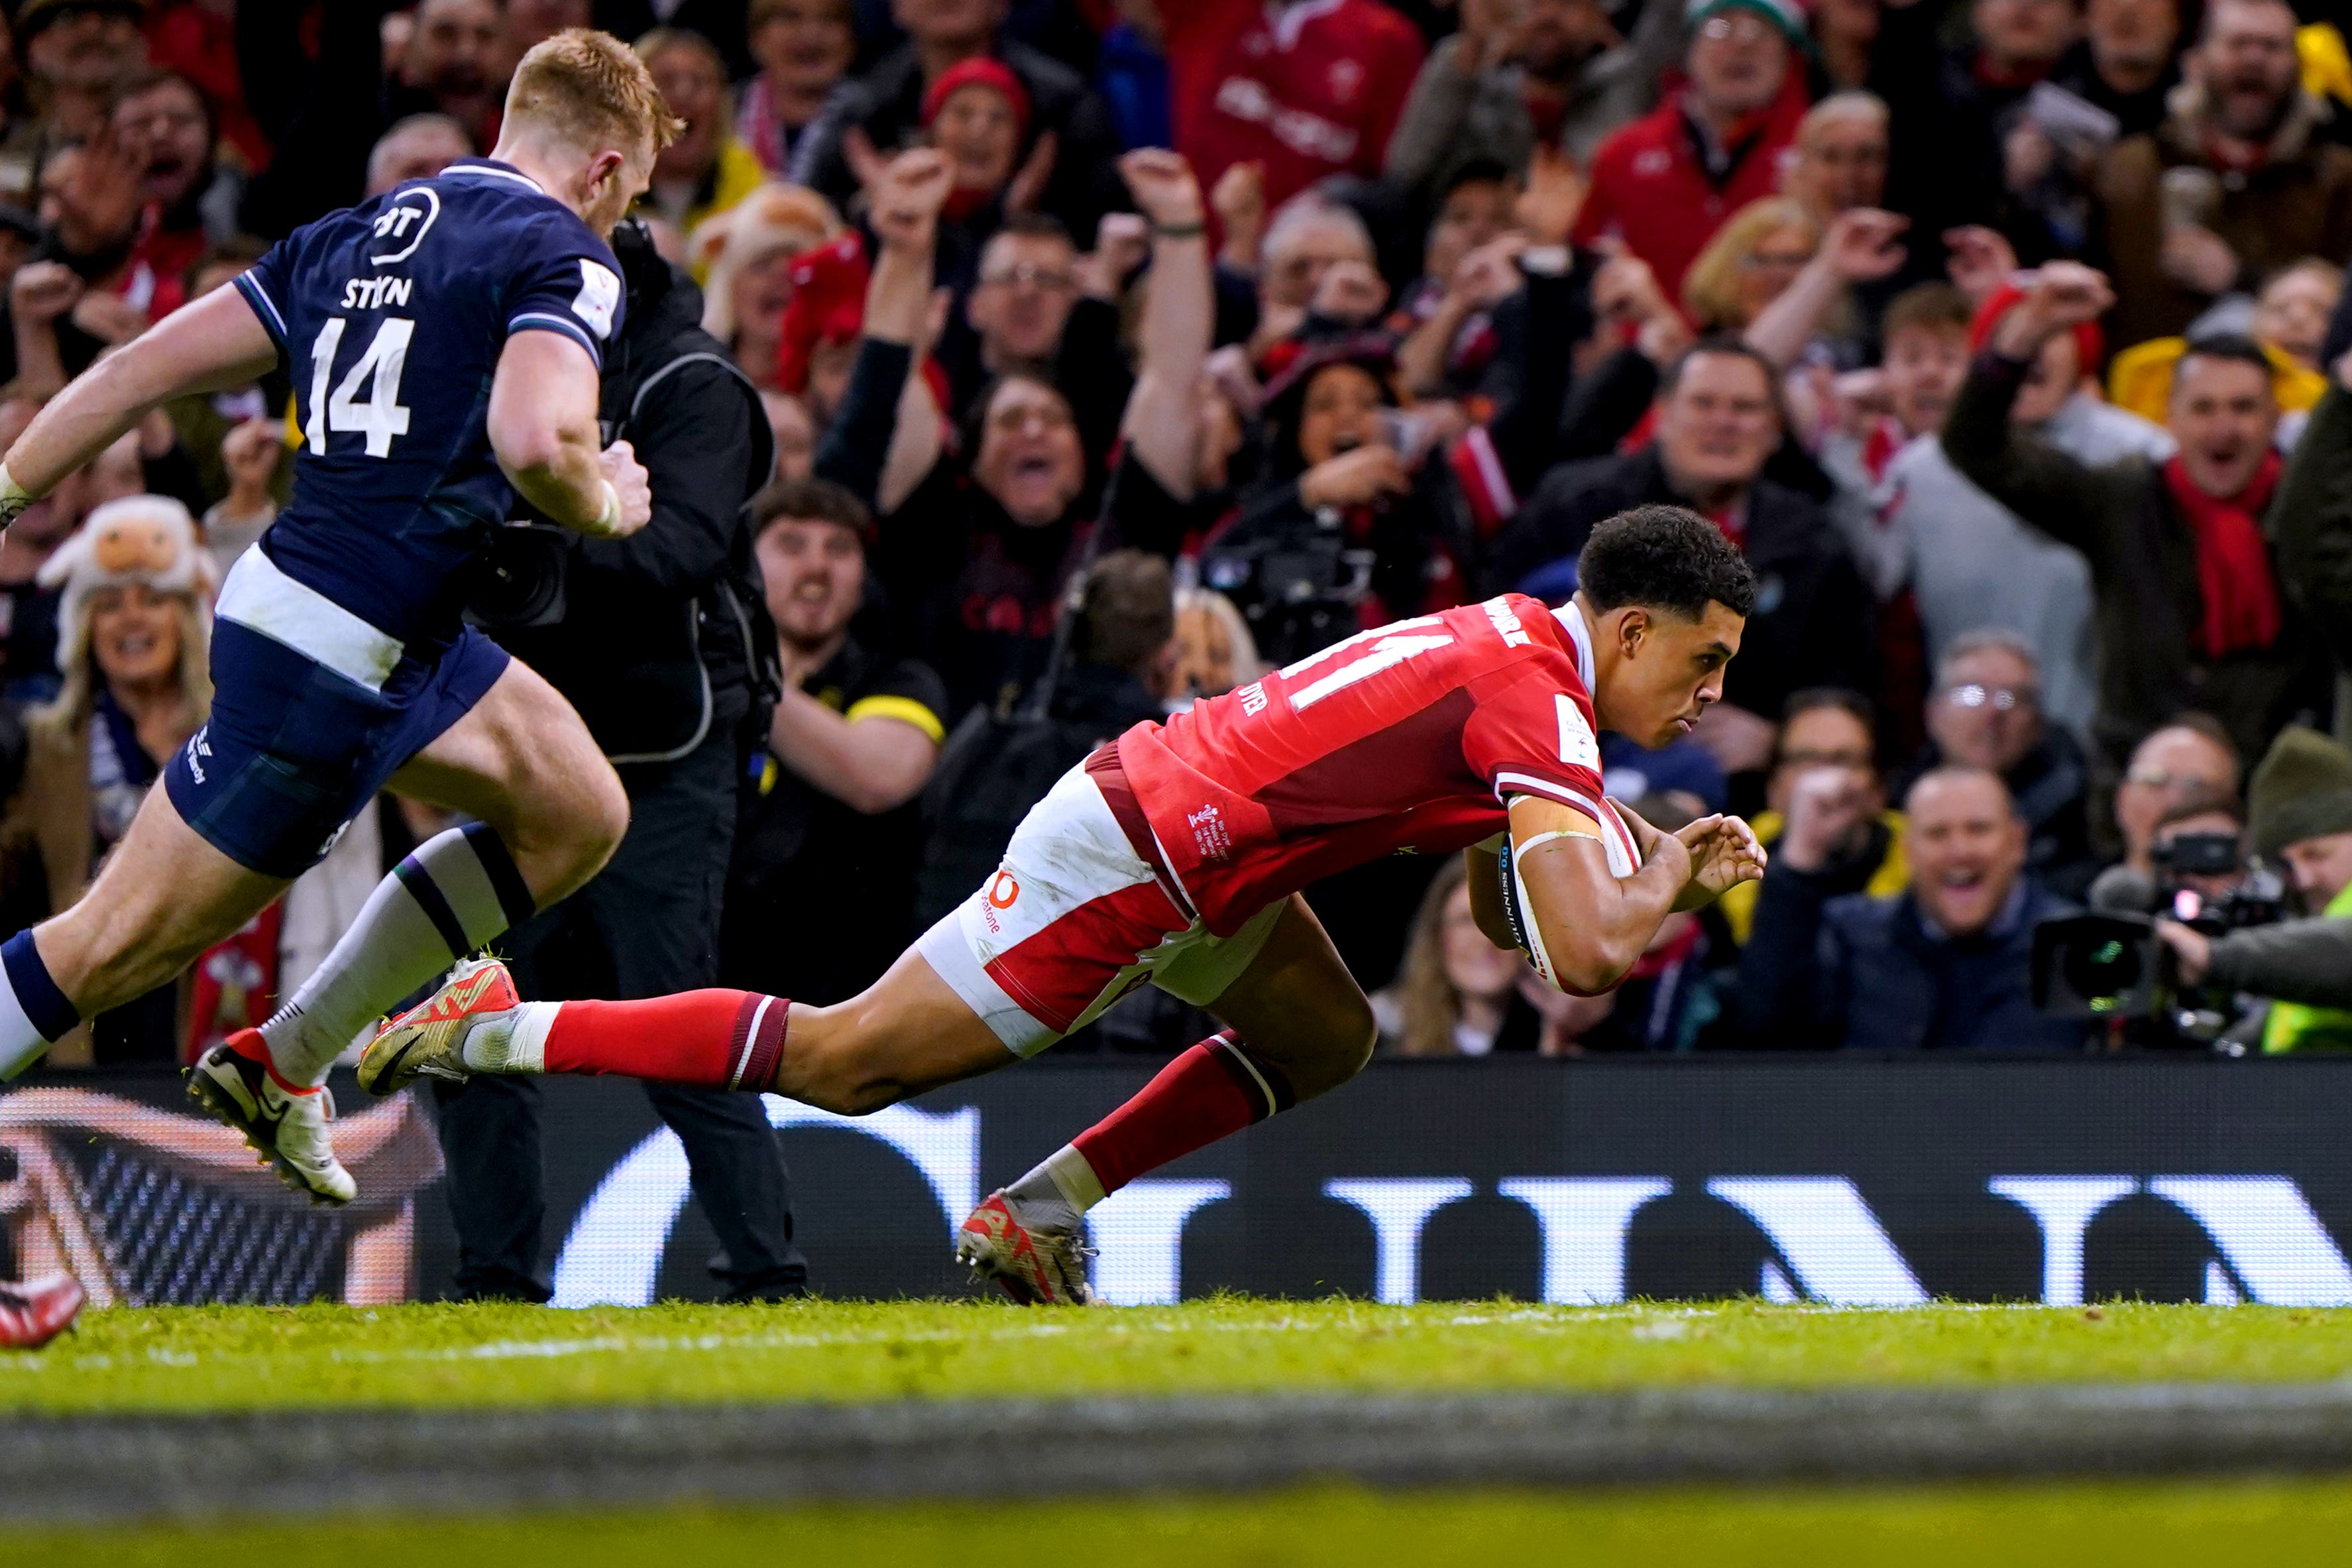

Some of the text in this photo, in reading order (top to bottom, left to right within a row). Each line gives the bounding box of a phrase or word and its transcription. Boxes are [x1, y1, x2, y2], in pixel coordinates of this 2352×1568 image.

[306, 317, 415, 459] 14
[1237, 681, 1268, 717] DYER
[1278, 616, 1455, 713] 11
[1500, 846, 1522, 944] GUINNESS 0.0
